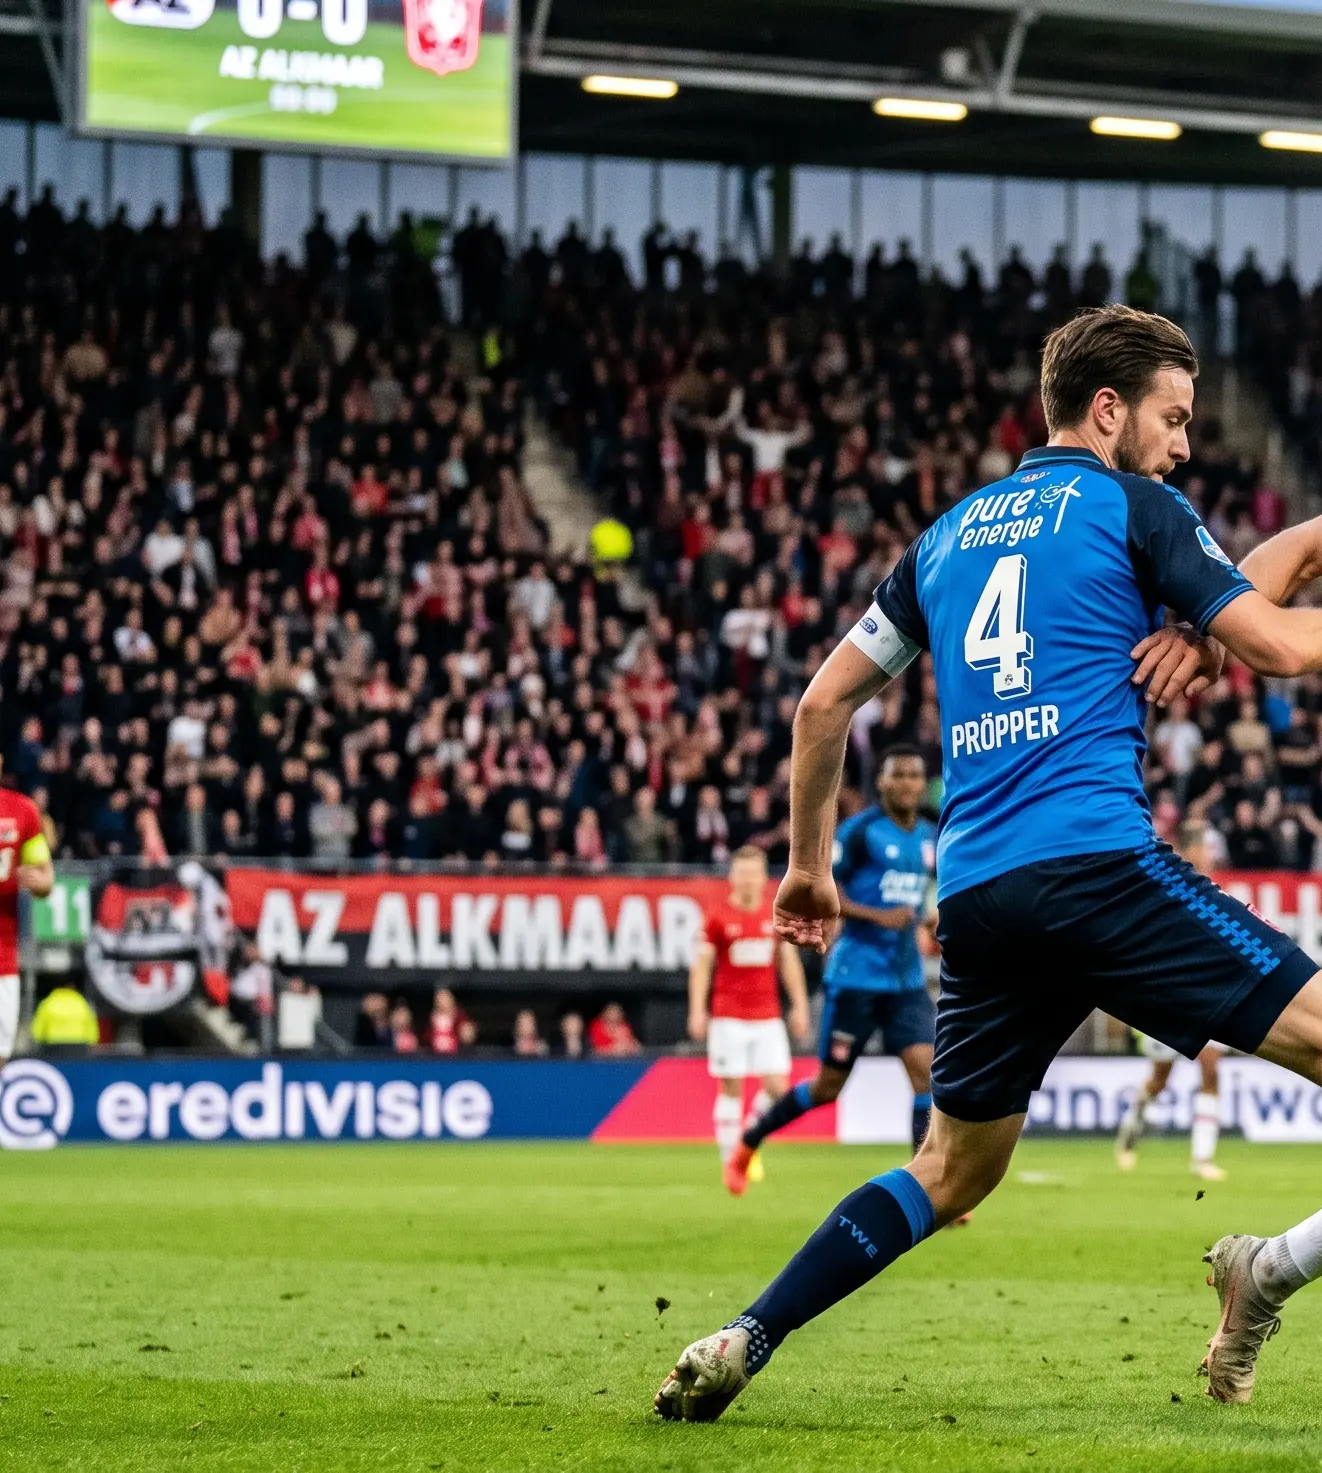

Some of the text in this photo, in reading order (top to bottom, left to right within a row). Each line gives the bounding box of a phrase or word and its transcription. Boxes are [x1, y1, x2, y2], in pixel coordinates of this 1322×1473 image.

[957, 488, 1036, 536] pure
[960, 515, 1043, 550] energie
[964, 553, 1033, 700] 4
[952, 704, 1059, 758] PRÖPPER
[256, 889, 703, 970] AZ ALKMAAR
[97, 1061, 493, 1139] eredivisie
[839, 1215, 878, 1259] TWE
